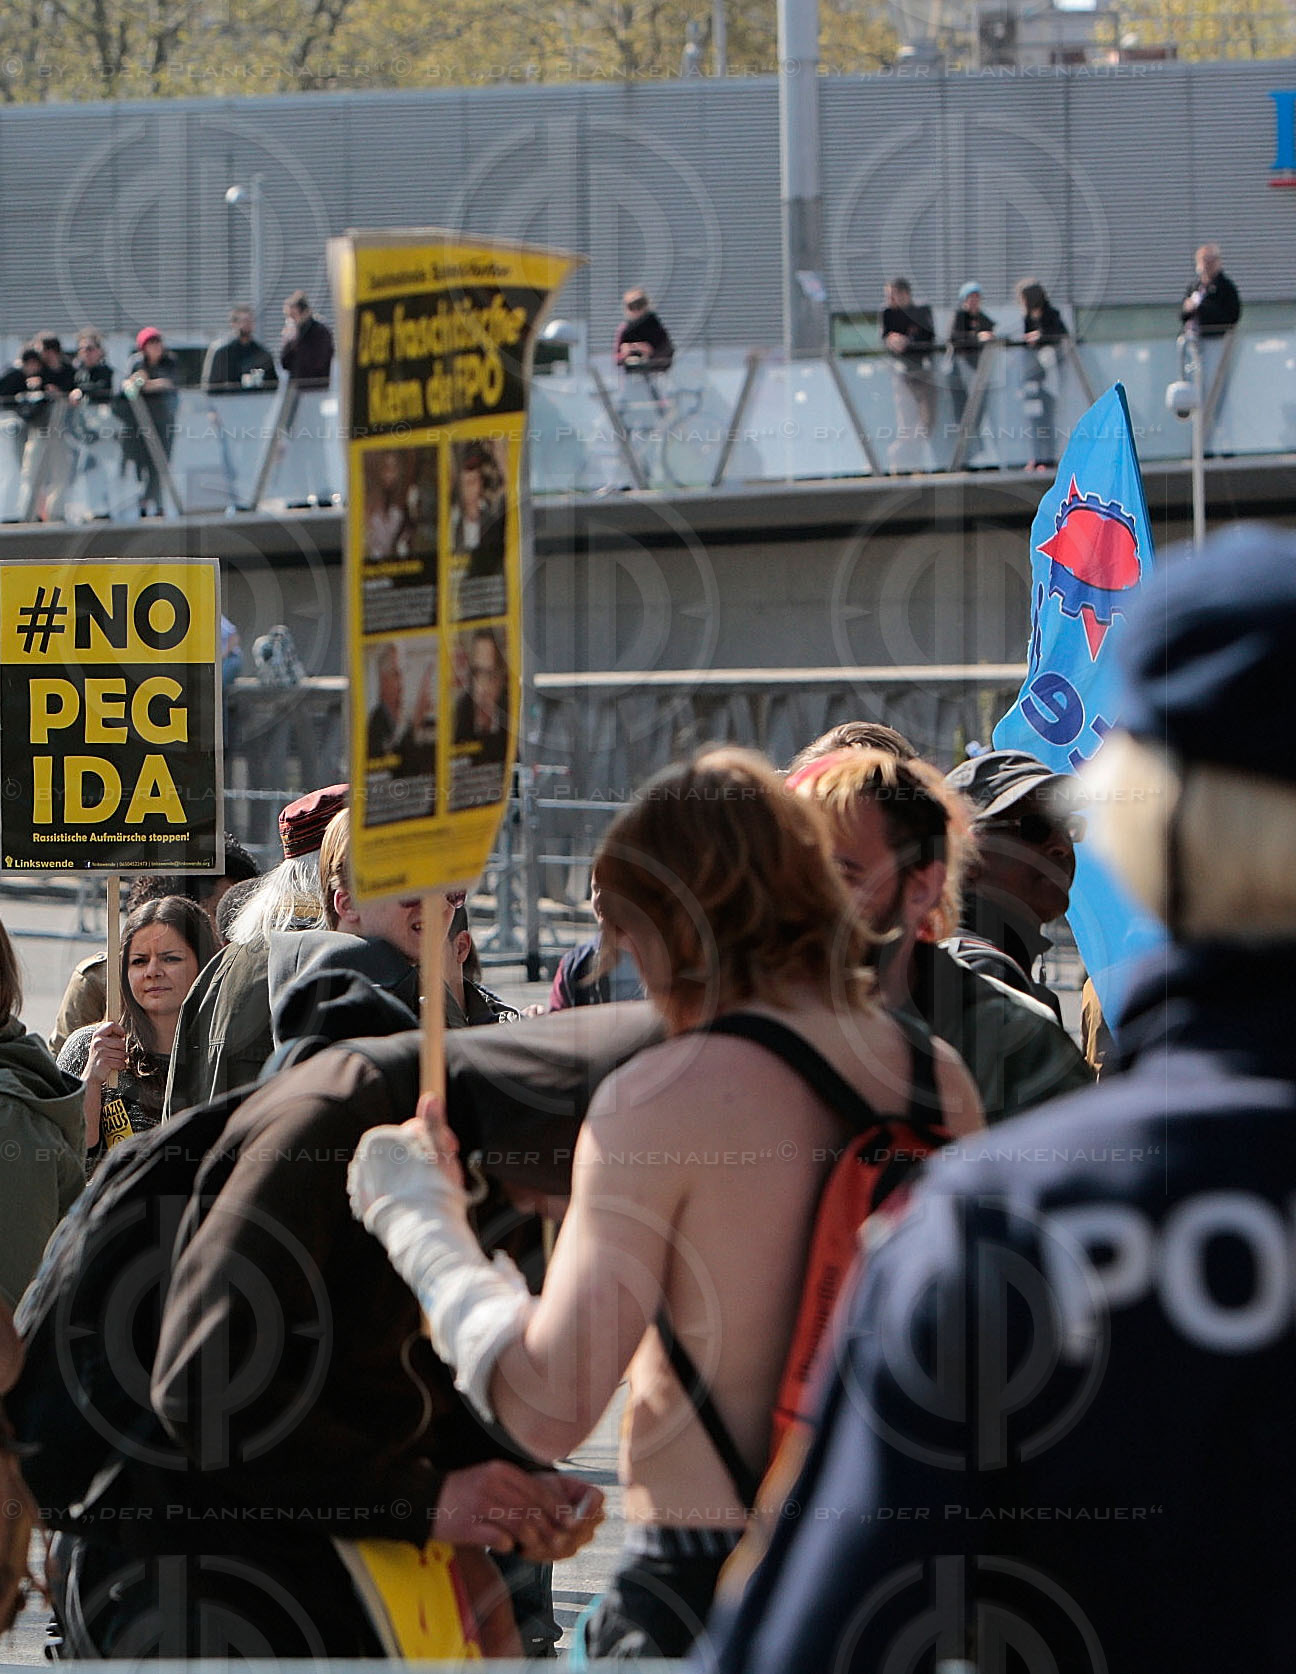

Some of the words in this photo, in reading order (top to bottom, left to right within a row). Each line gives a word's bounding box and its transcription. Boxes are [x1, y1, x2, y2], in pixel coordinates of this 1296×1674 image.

[16, 582, 191, 654] #NO
[29, 676, 188, 744] PEG
[32, 754, 187, 824] IDA
[14, 858, 74, 868] Linkswende
[32, 832, 88, 843] Rassistische
[89, 832, 147, 843] Aufmärsche
[148, 831, 190, 844] stoppen!
